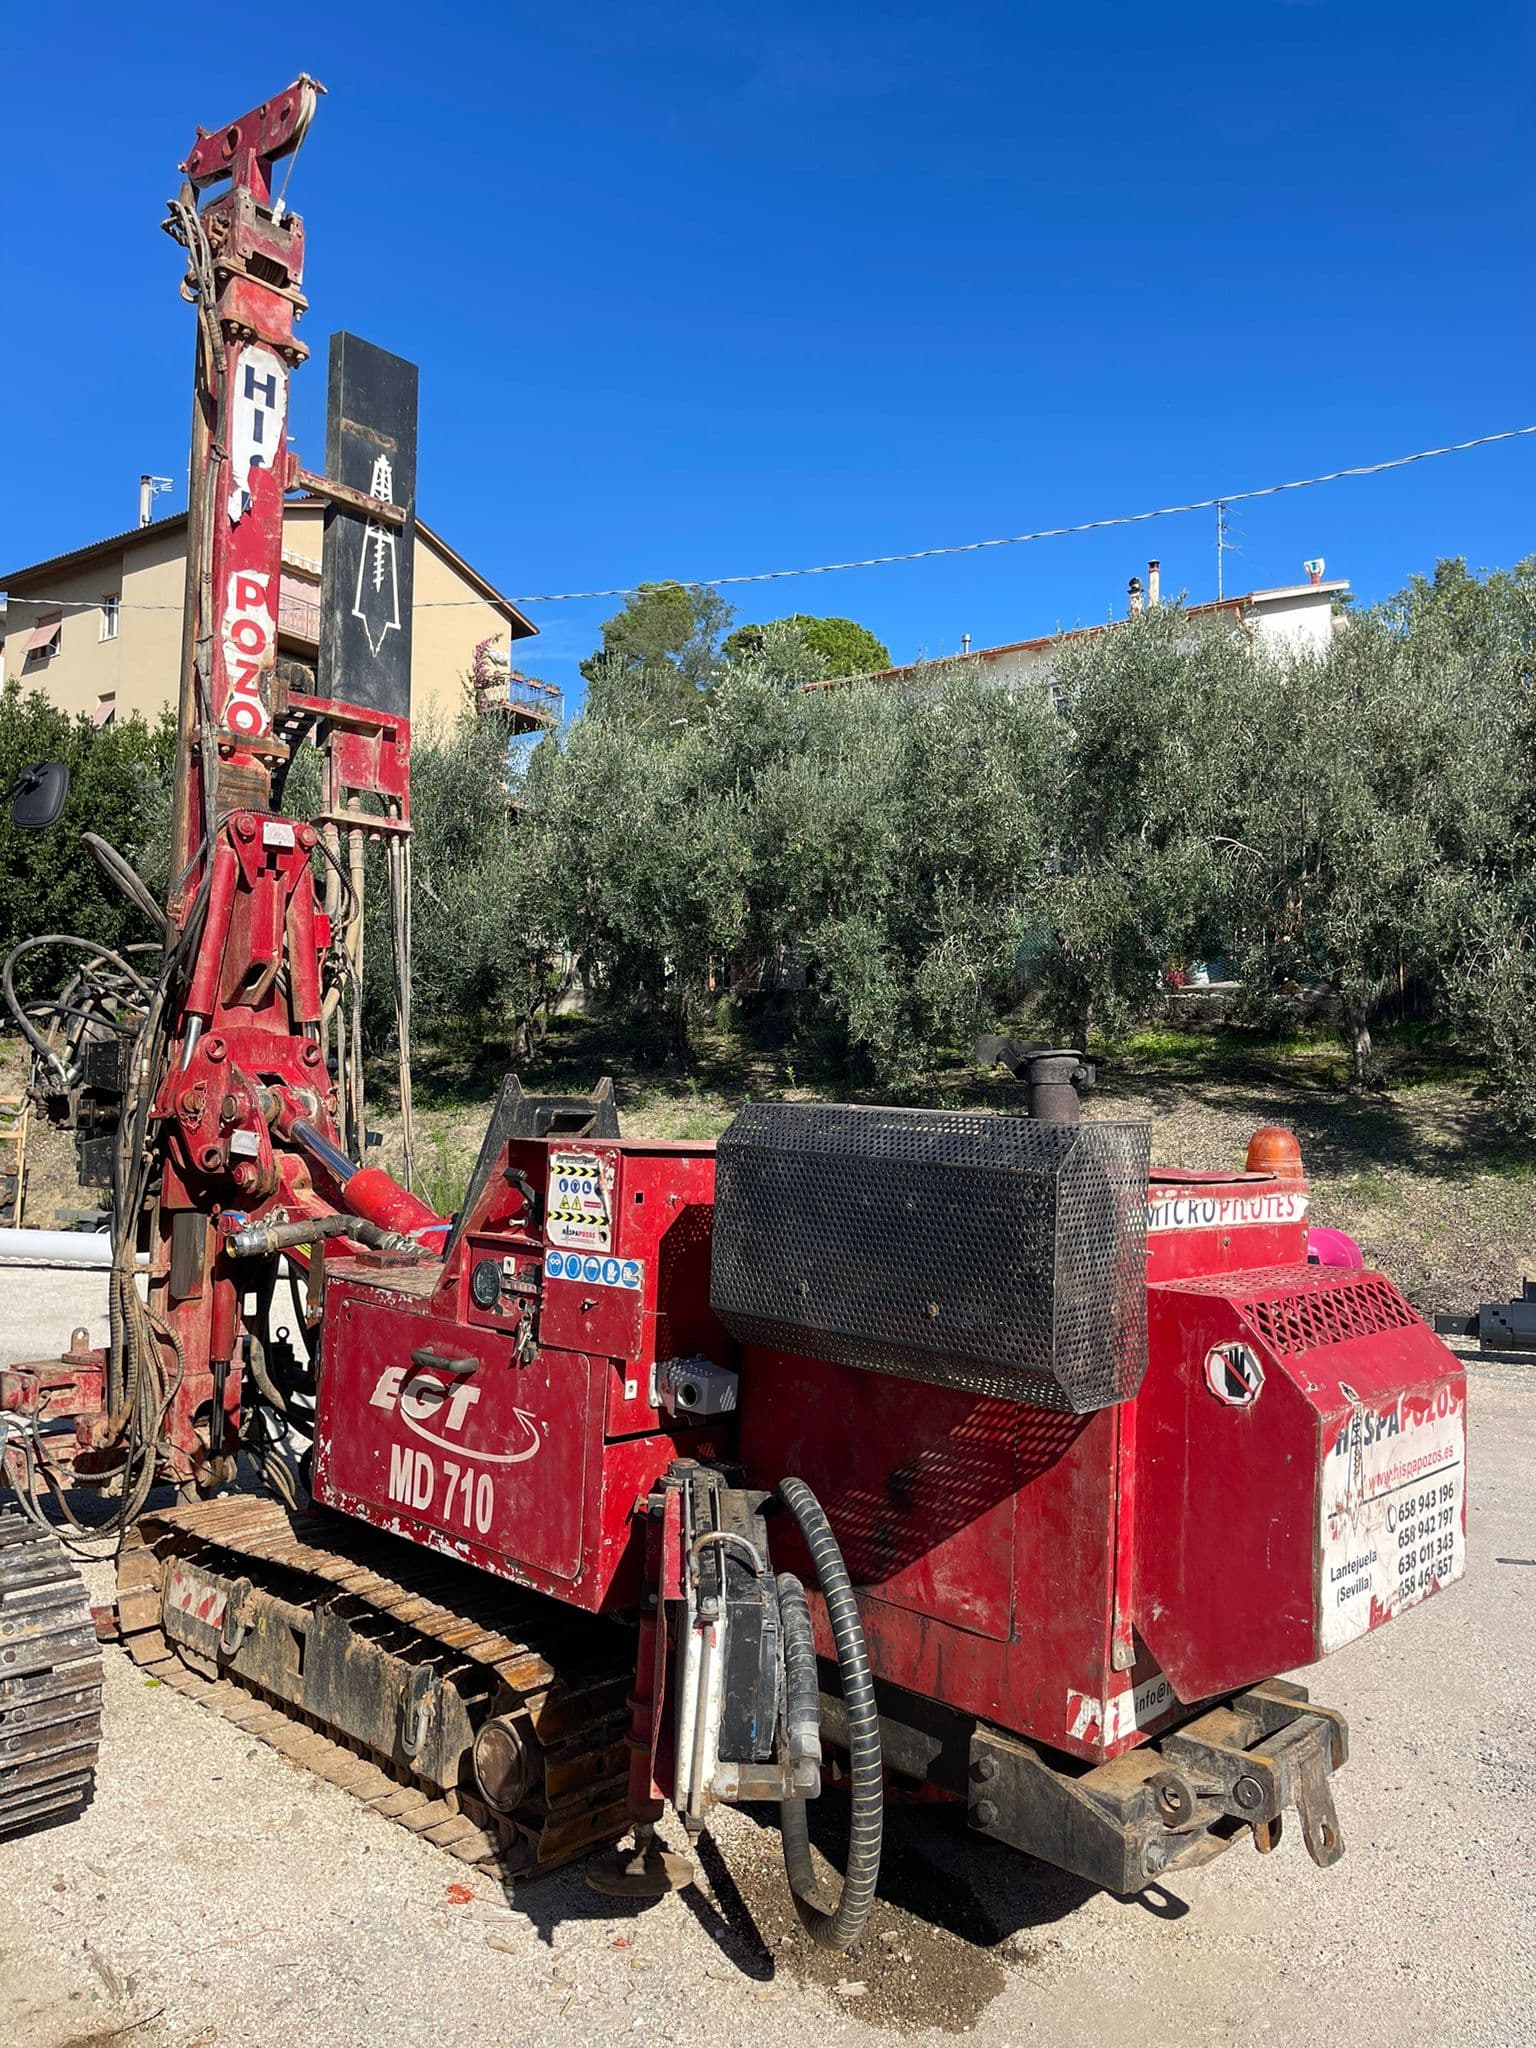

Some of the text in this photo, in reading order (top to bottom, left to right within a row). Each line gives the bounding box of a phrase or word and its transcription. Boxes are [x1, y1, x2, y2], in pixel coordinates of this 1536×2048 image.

[227, 577, 267, 735] POZO
[1146, 1194, 1294, 1227] MICROPILOTES
[369, 1366, 481, 1431] EGT
[389, 1444, 494, 1534] MD 710
[1367, 1445, 1454, 1490] www.hispapozos.es
[1398, 1481, 1454, 1522] 658 943 196
[1398, 1506, 1454, 1549] 658 942 797
[1330, 1549, 1377, 1583] Lantejuela
[1398, 1531, 1454, 1575] 638 011 343
[1336, 1572, 1372, 1608] (Sevilla)
